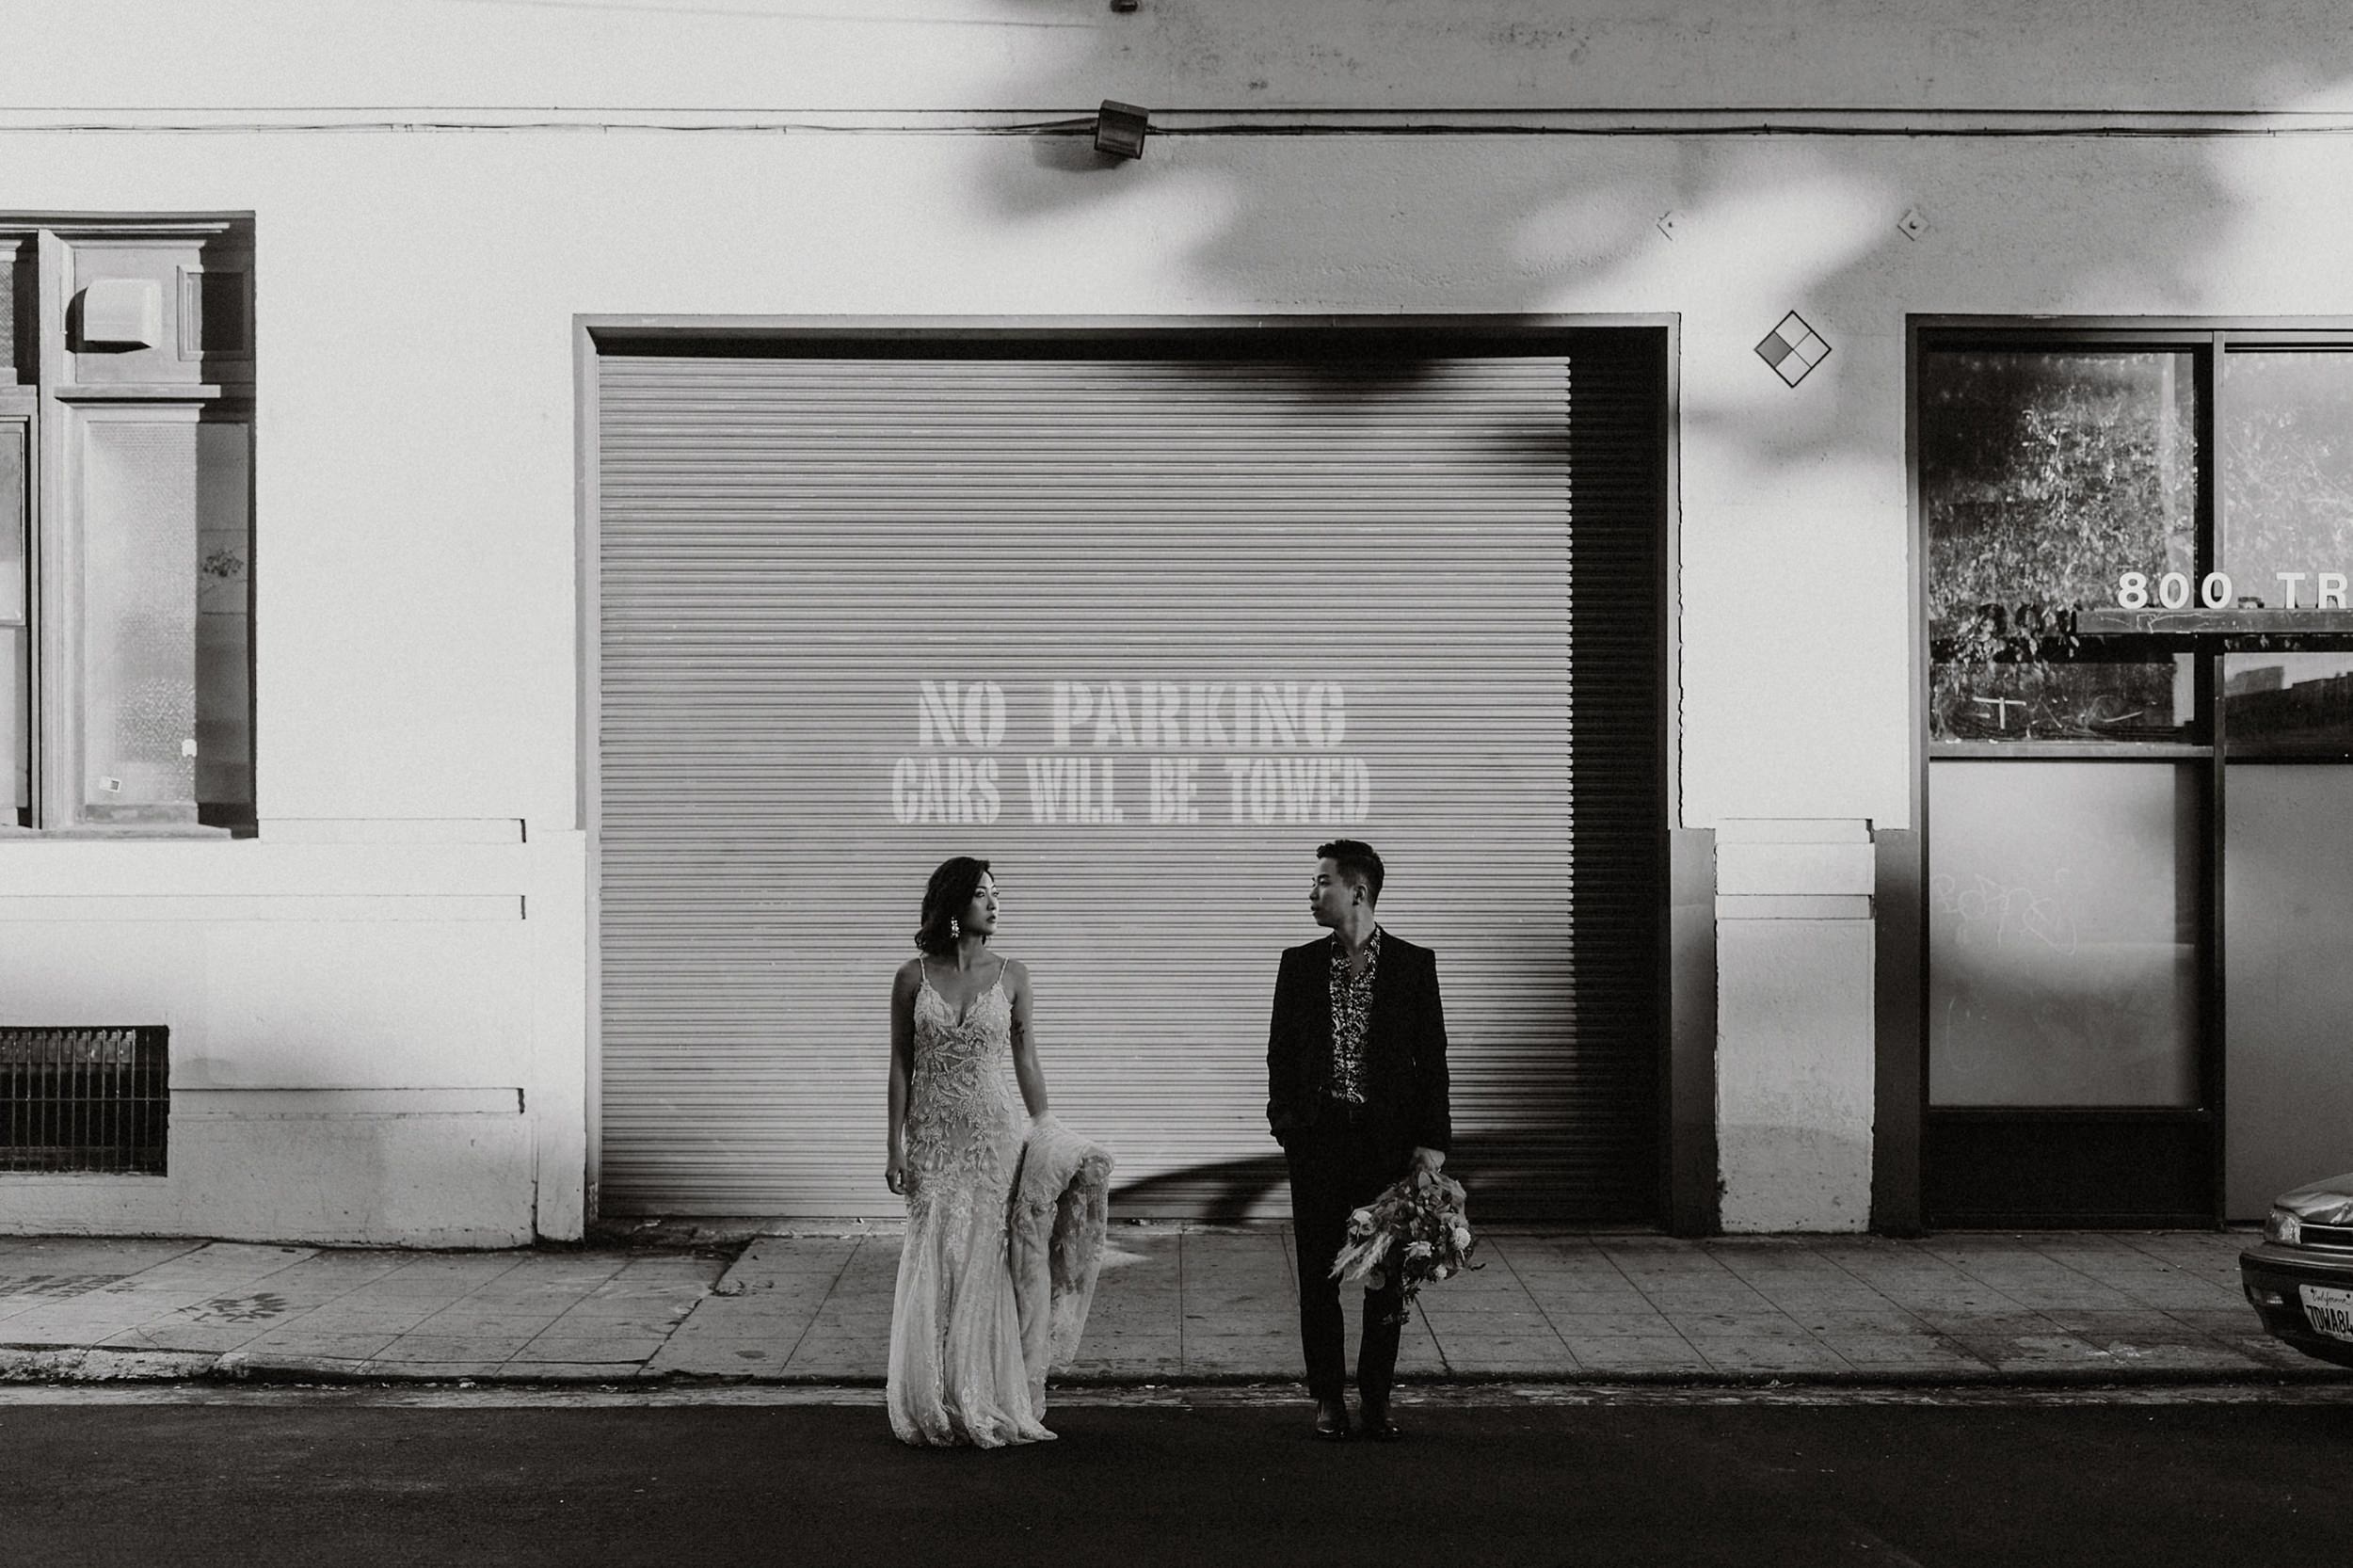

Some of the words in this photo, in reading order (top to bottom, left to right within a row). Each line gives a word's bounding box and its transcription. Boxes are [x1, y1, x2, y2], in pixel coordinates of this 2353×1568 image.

[2118, 571, 2233, 609] 800
[2276, 571, 2348, 609] TR
[919, 680, 1006, 747] NO
[1053, 680, 1346, 747] PARKING
[892, 757, 1000, 824] CARS
[1026, 757, 1123, 824] WILL
[1150, 757, 1199, 824] BE
[1225, 757, 1369, 824] TOWED
